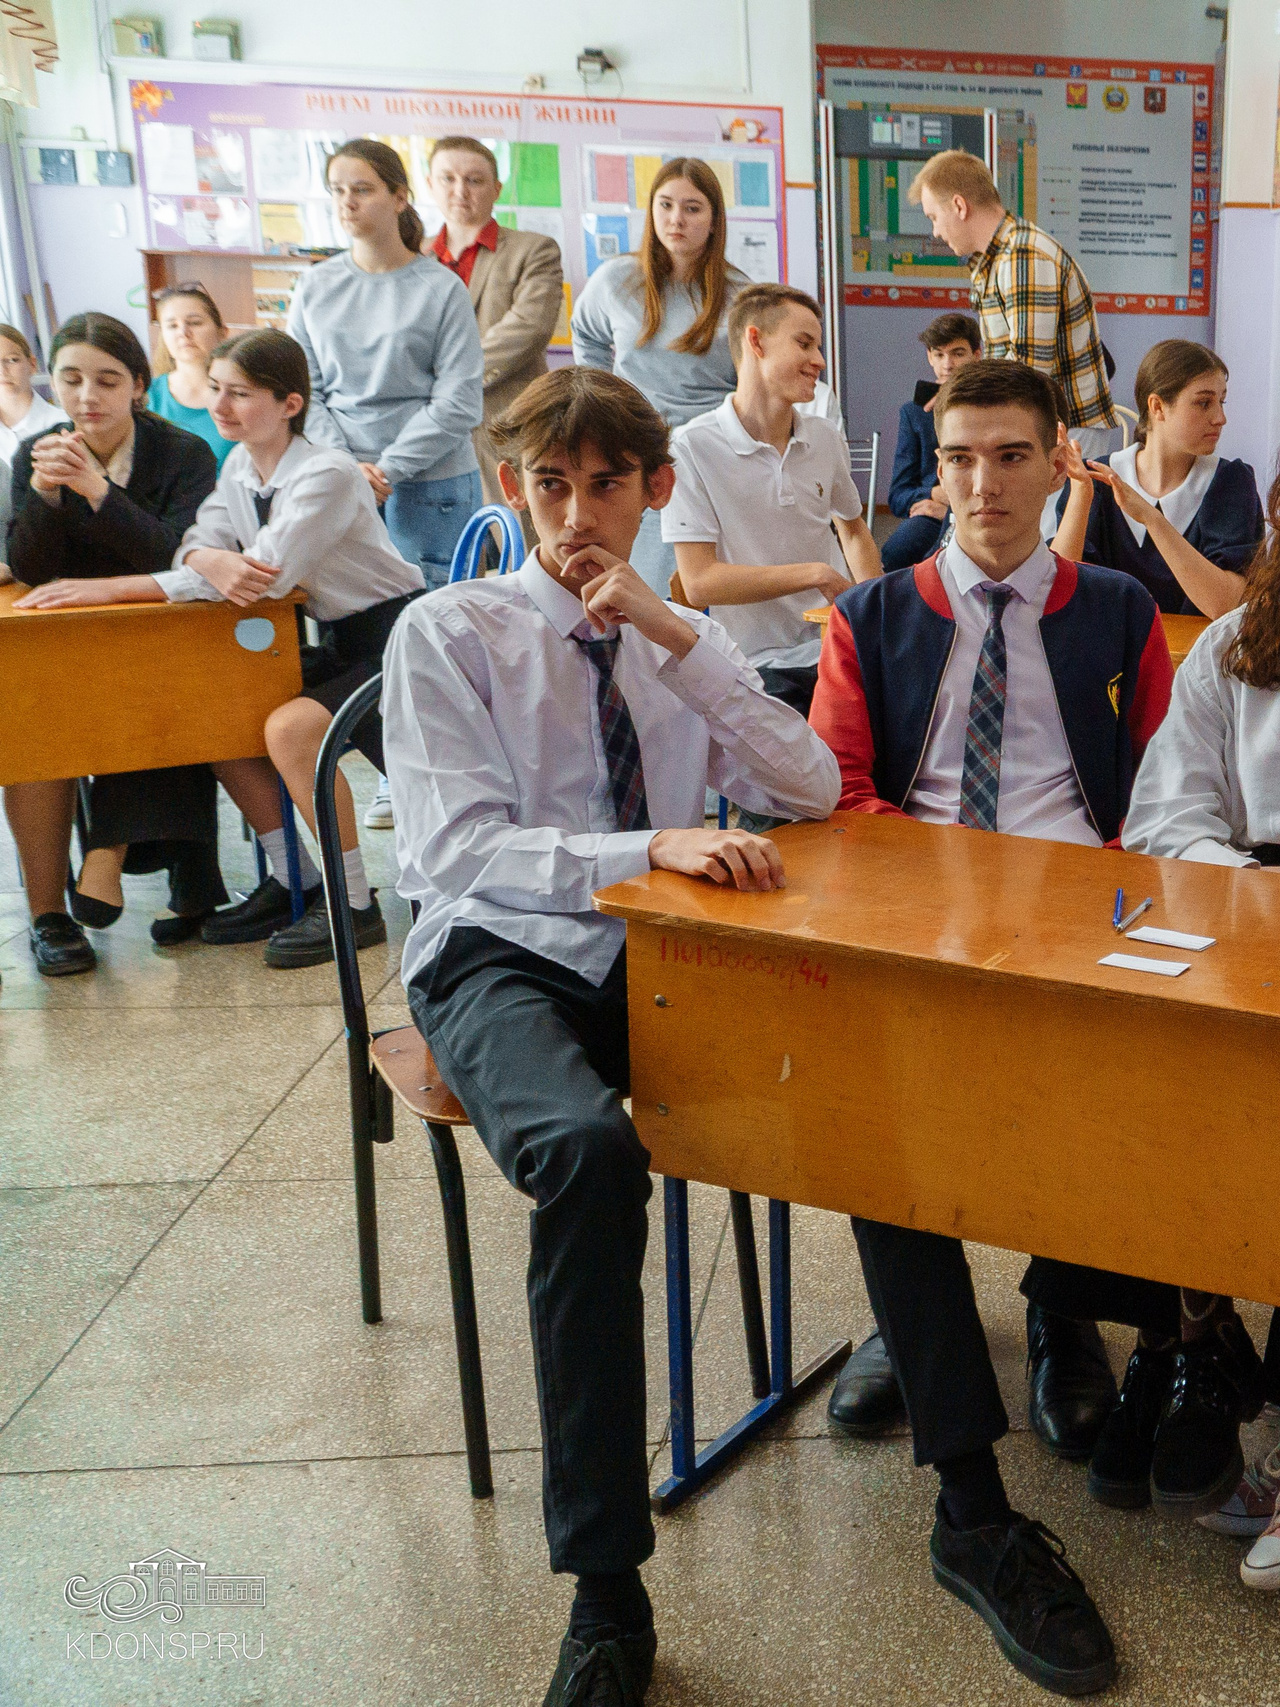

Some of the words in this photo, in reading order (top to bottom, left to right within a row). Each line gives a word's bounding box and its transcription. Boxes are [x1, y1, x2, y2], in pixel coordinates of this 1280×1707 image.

[305, 92, 372, 114] РИТМ
[384, 95, 522, 121] ШКОЛЬНОЙ
[532, 103, 618, 126] ЖИЗНИ
